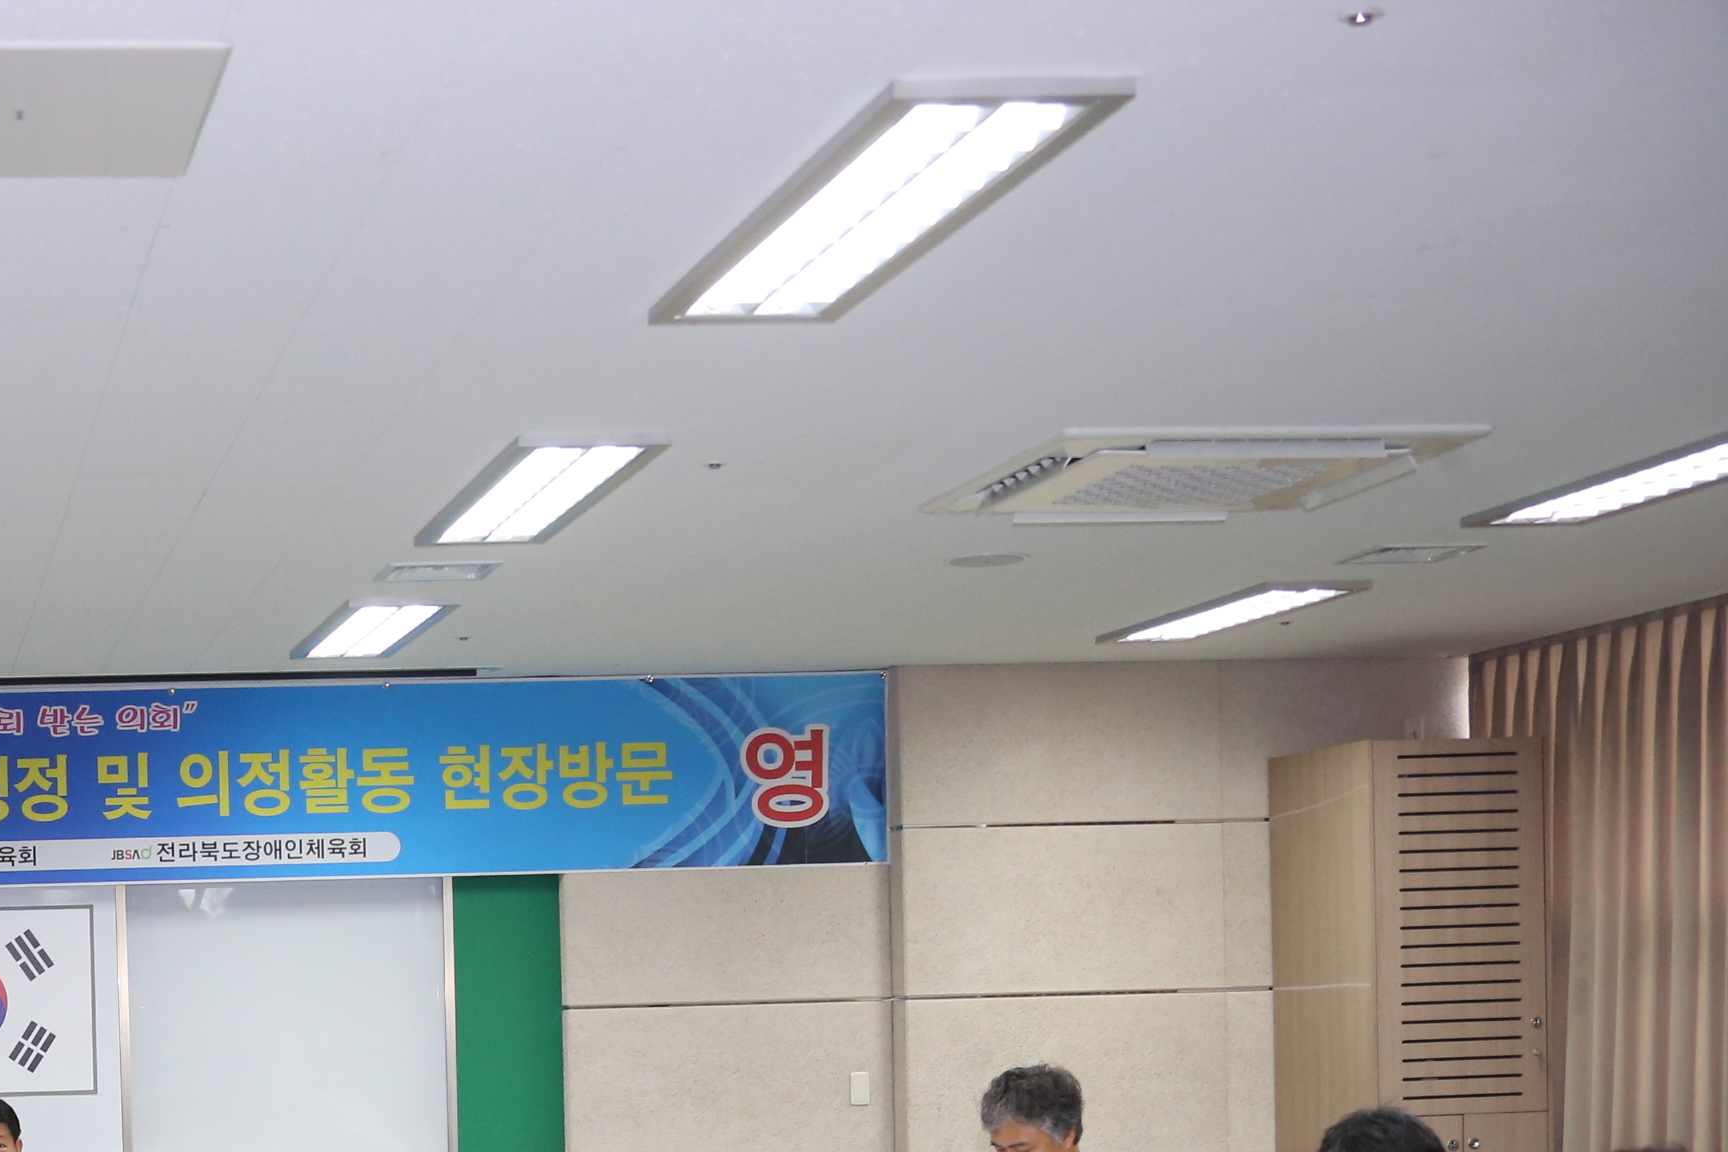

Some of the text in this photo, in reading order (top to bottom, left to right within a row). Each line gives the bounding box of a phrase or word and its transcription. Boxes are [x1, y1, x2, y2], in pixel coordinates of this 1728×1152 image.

[38, 705, 105, 738] 받는
[97, 753, 152, 820] 및
[177, 745, 416, 817] 의정활동
[439, 742, 674, 811] 현장방문
[743, 727, 829, 824] 영
[156, 836, 368, 863] 전라북도장애인체육회
